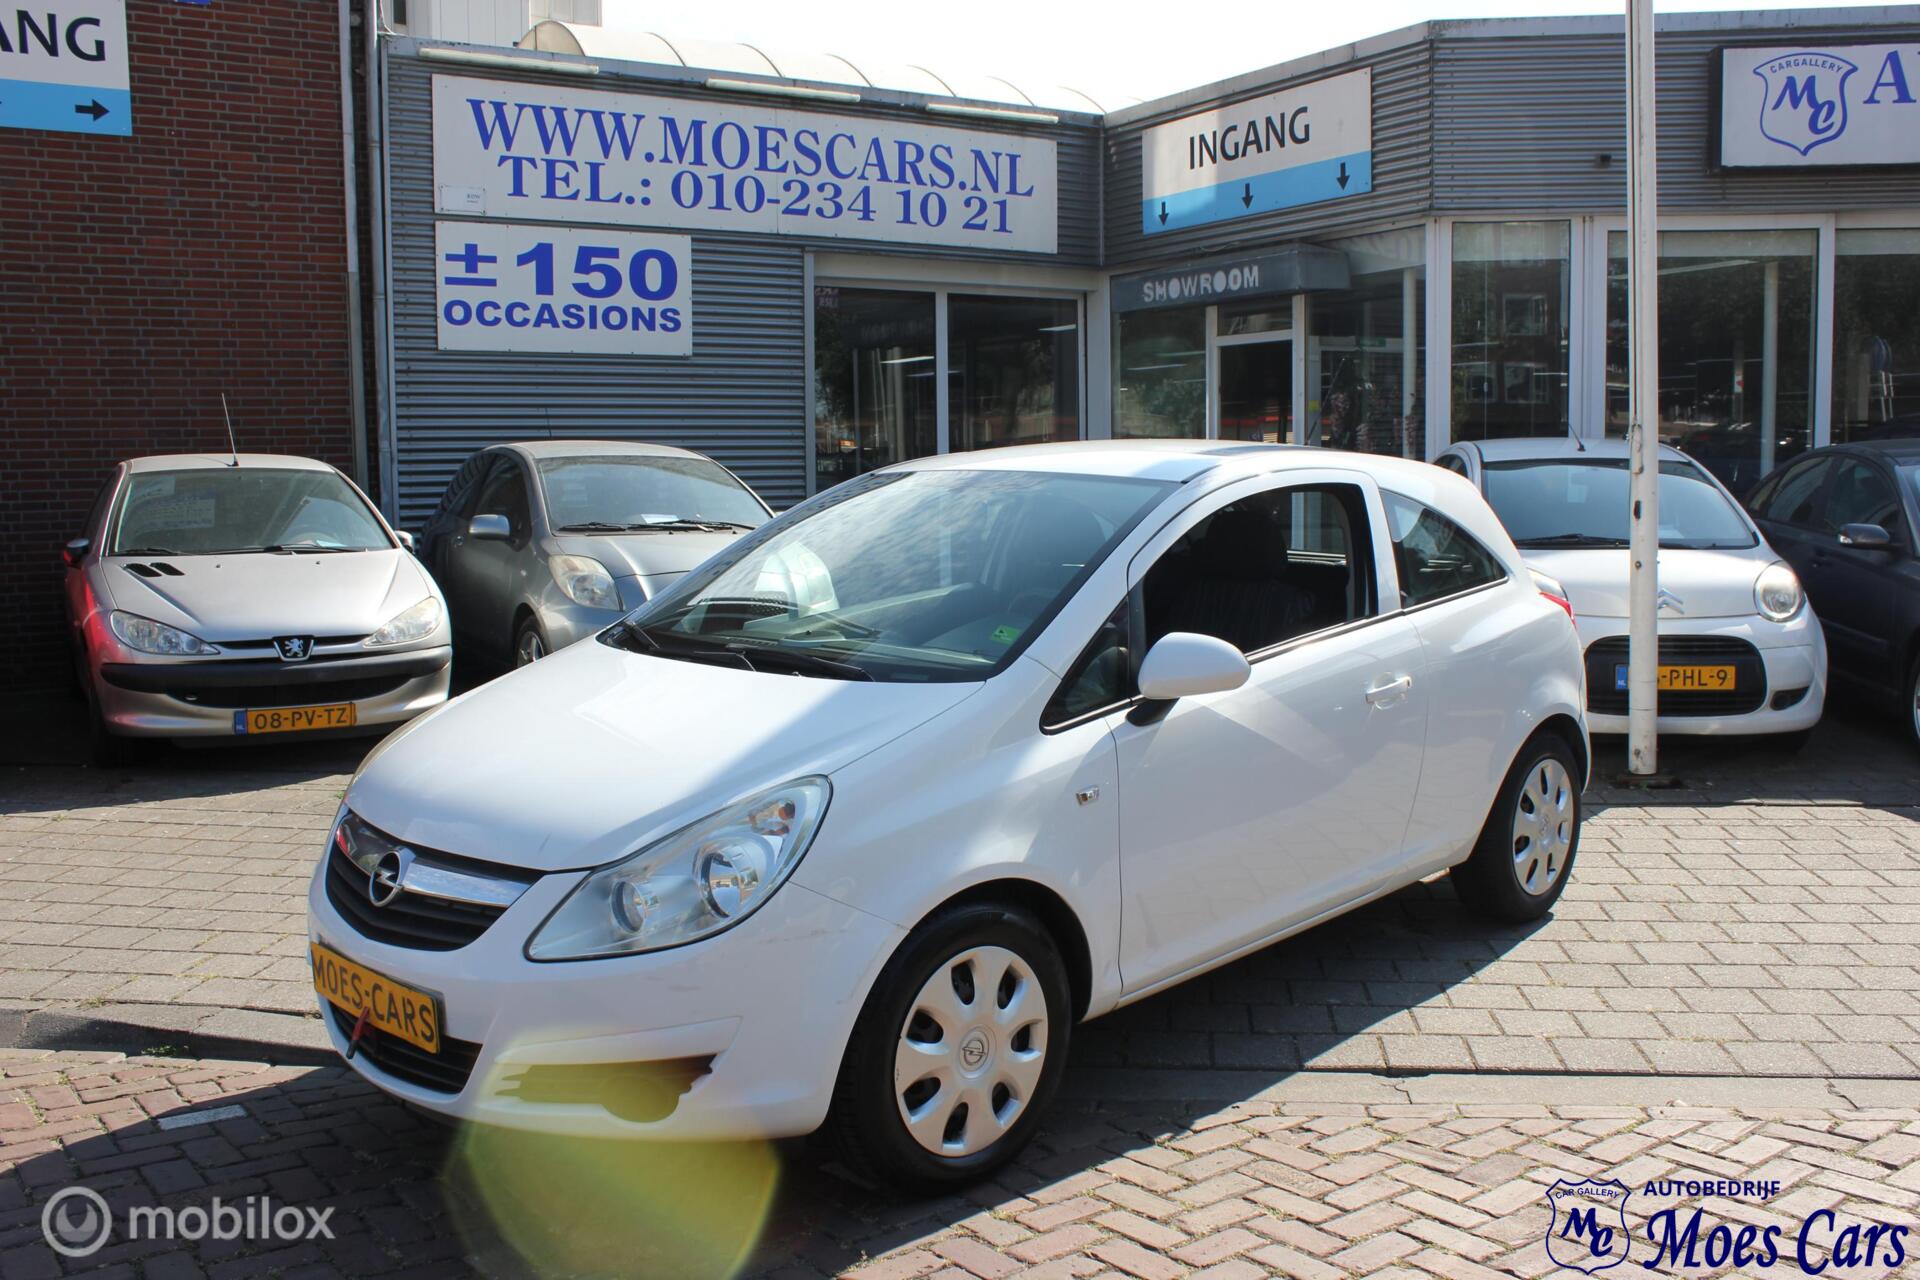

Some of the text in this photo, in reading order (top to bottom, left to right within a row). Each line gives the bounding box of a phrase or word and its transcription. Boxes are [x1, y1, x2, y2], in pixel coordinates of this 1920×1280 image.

[1770, 58, 1843, 74] CARGALLERY
[465, 98, 1034, 200] WWW.MOESCARS.NL
[1190, 106, 1311, 170] INGANG
[497, 154, 1013, 235] TEL.: 010-234 10 21
[1143, 265, 1260, 303] SHOWROOM
[443, 302, 682, 333] OCCASIONS
[254, 707, 348, 730] 08-PV-TZ
[312, 954, 436, 1043] MOES-CARS
